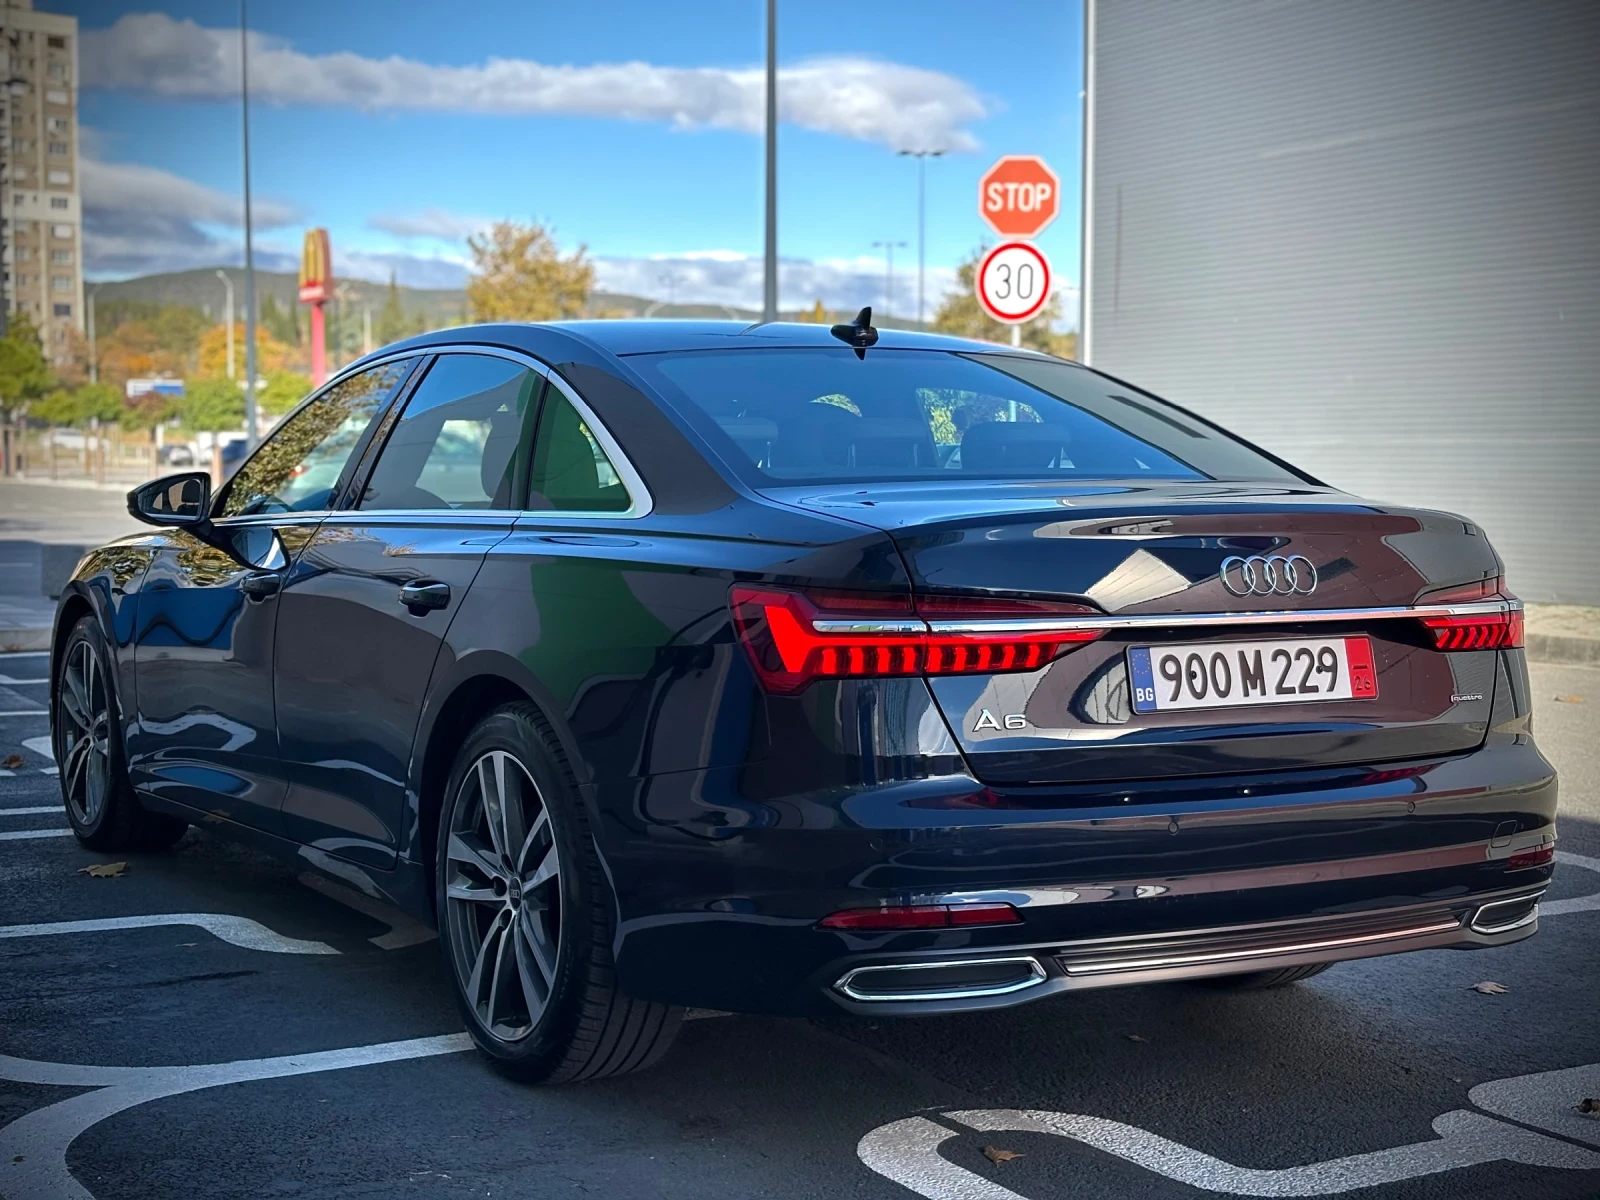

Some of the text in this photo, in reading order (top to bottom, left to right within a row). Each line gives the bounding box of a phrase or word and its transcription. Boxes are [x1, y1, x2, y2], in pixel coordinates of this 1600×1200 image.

[986, 182, 1051, 213] STOP
[995, 263, 1034, 300] 30
[1159, 646, 1338, 702] 900 M 229
[1354, 675, 1372, 691] 26
[1136, 687, 1154, 702] BG
[972, 708, 1027, 732] A6
